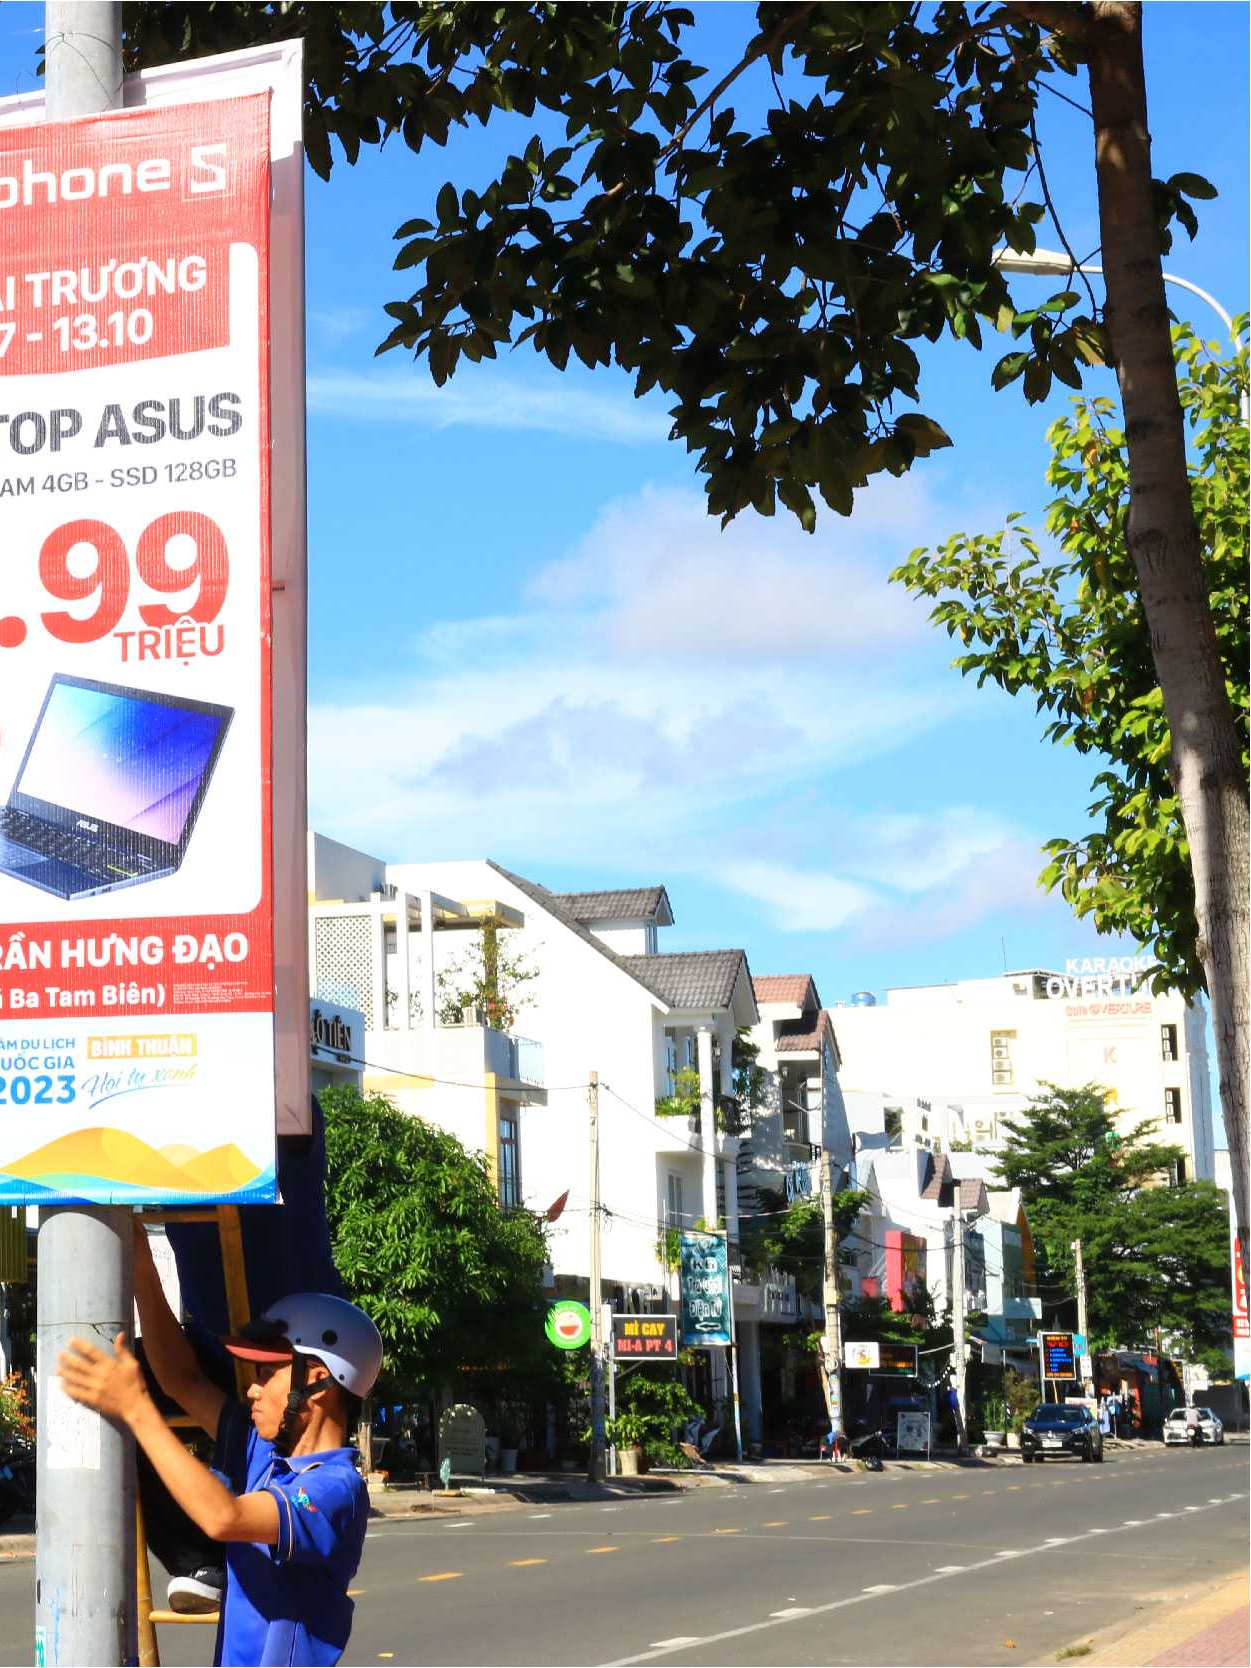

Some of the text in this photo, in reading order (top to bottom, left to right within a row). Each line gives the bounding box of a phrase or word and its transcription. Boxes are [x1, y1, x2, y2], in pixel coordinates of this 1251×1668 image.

[25, 255, 207, 309] TRƯƠNG
[53, 308, 154, 352] 13.10
[94, 391, 243, 450] ASUS
[41, 471, 88, 495] 4GB
[110, 465, 158, 488] SSD
[165, 457, 238, 483] 128GB
[114, 615, 225, 667] TRIỆU
[61, 933, 164, 969] HƯNG
[172, 932, 249, 971] ĐẠO
[10, 988, 41, 1009] Ba
[45, 986, 95, 1008] Tam
[103, 983, 166, 1008] Biên)
[21, 1038, 40, 1050] DU
[44, 1056, 75, 1069] GIA
[641, 1322, 665, 1336] CAY
